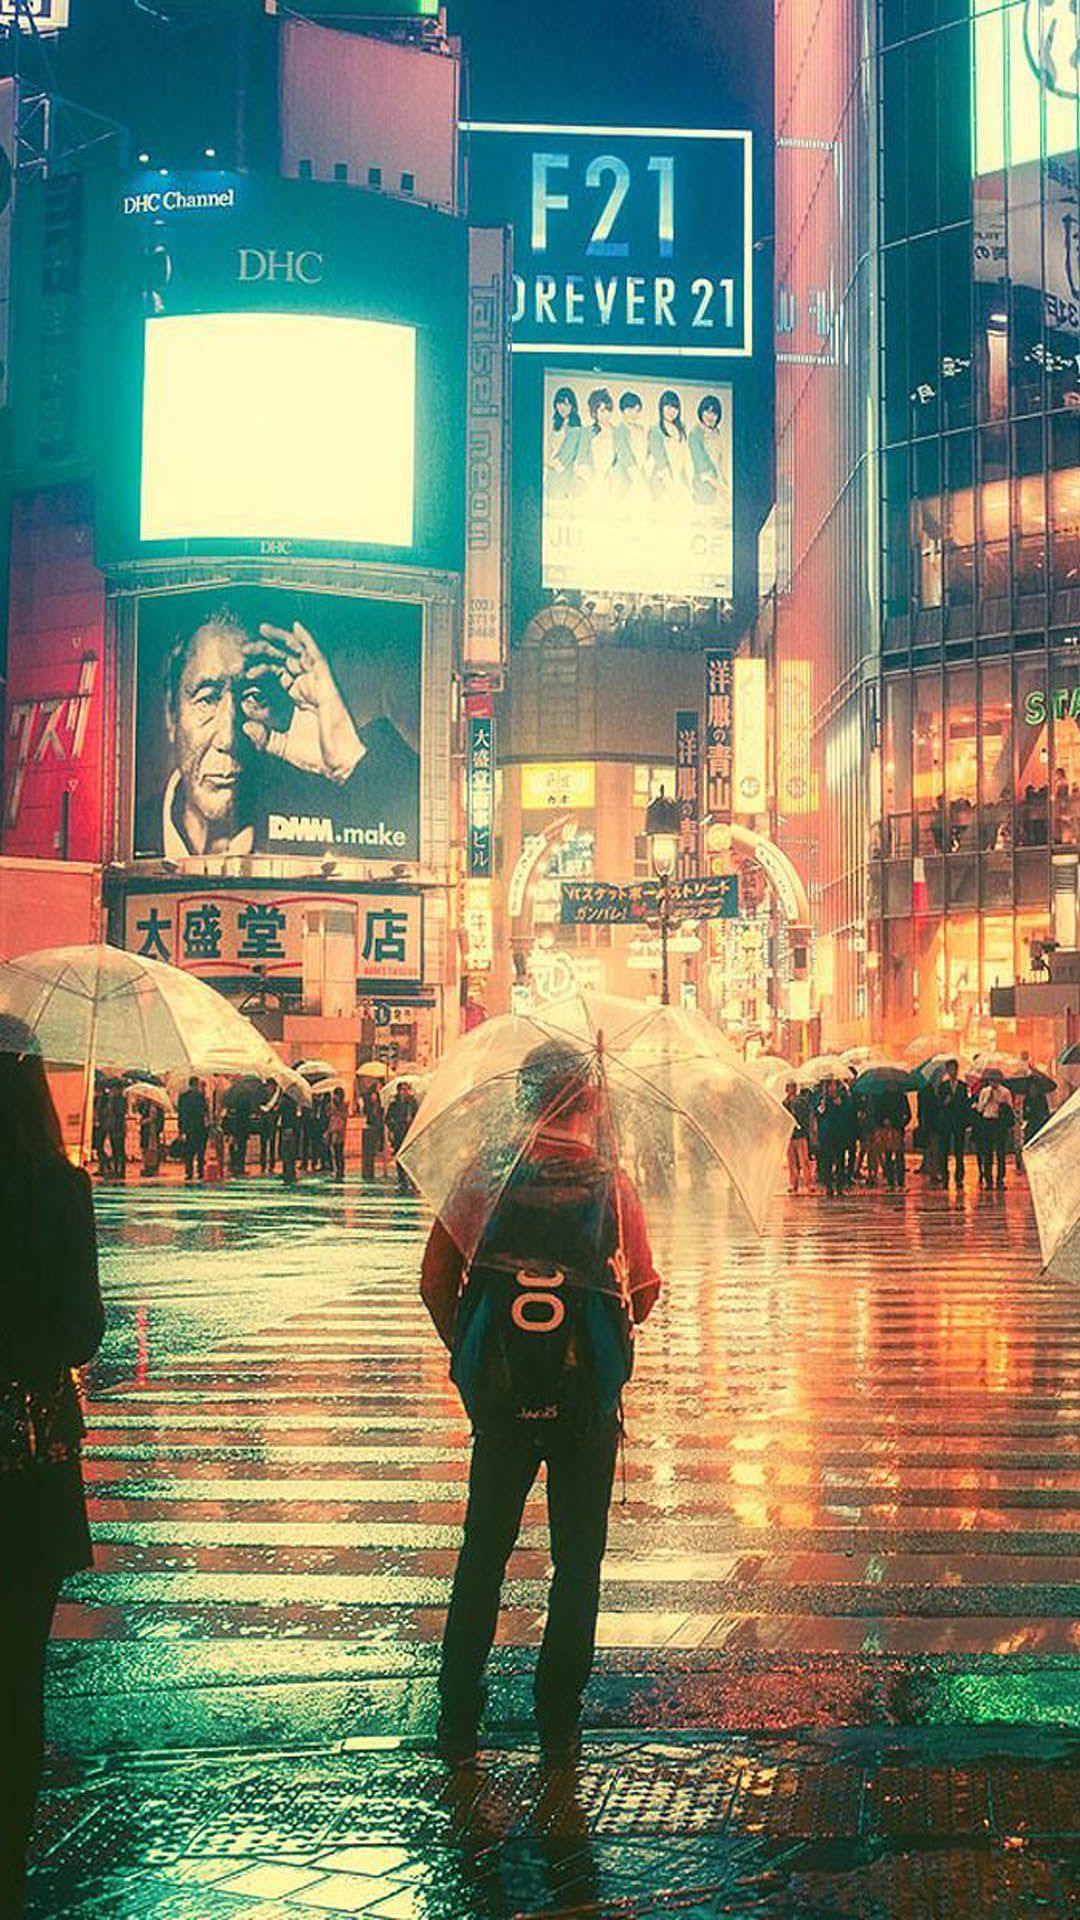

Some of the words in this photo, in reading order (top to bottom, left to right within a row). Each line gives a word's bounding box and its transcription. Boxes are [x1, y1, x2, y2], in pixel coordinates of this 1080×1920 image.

[124, 193, 161, 214] DHC
[163, 189, 234, 210] Channel
[532, 153, 674, 257] F21
[237, 248, 323, 284] DHC
[691, 278, 734, 328] 21
[469, 430, 492, 552] neon
[261, 541, 292, 555] DHC
[268, 814, 406, 847] DMM.make
[136, 903, 408, 962] 大盛堂店
